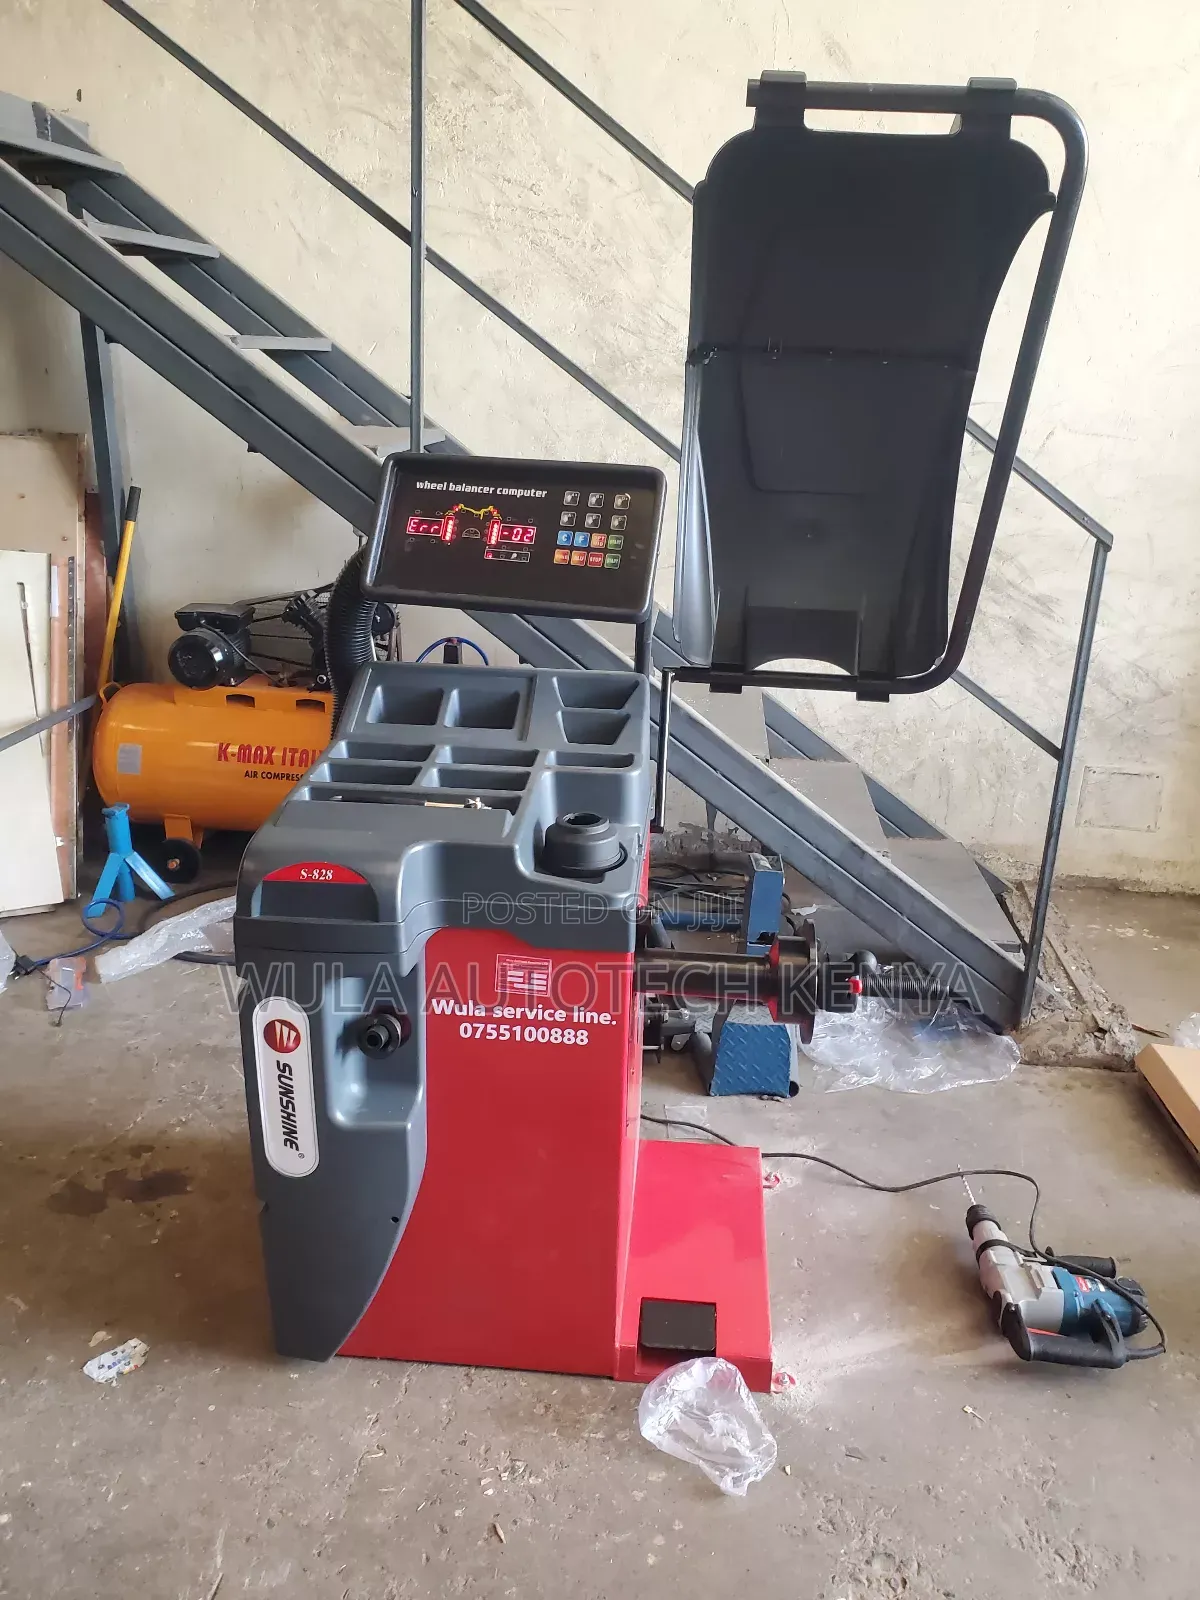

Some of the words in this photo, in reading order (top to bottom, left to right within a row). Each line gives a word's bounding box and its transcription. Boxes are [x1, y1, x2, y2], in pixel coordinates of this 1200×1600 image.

[416, 481, 447, 491] wheel
[448, 482, 495, 494] balancer
[496, 486, 548, 498] computer
[408, 519, 440, 532] Err
[217, 742, 277, 765] K-MAX
[281, 747, 323, 768] ITAL
[244, 770, 258, 779] AIR
[300, 868, 334, 881] S-828
[431, 998, 486, 1017] Wula
[492, 1003, 567, 1023] service
[572, 1005, 617, 1026] line.
[459, 1022, 589, 1046] 0755100888
[276, 1059, 300, 1152] SUNSHINE
